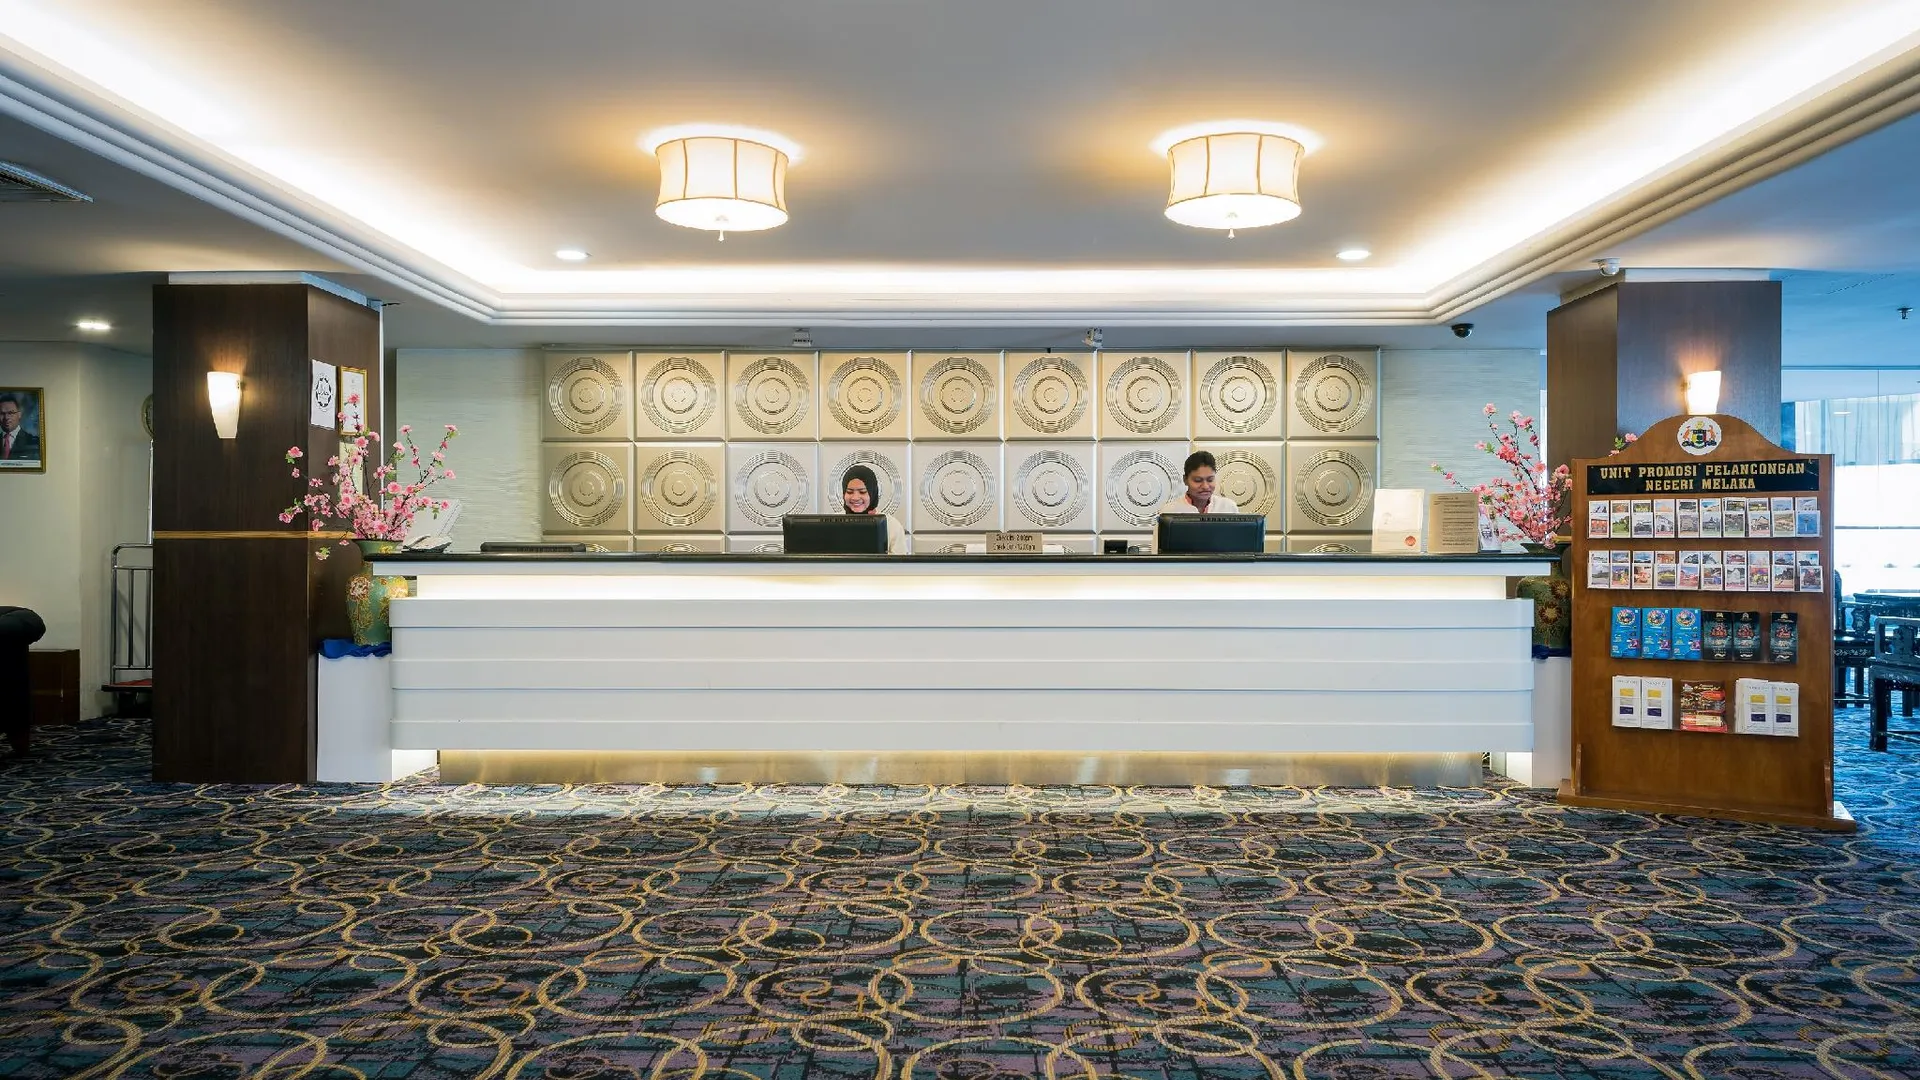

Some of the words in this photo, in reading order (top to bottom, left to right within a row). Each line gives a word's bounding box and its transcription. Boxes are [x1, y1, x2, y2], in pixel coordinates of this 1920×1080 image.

[1600, 466, 1632, 479] UNIT
[1638, 464, 1698, 478] PROMOSI
[1705, 462, 1805, 476] PELANCONGAN
[1645, 479, 1694, 492] NEGERI
[1701, 477, 1756, 491] MELAKA
